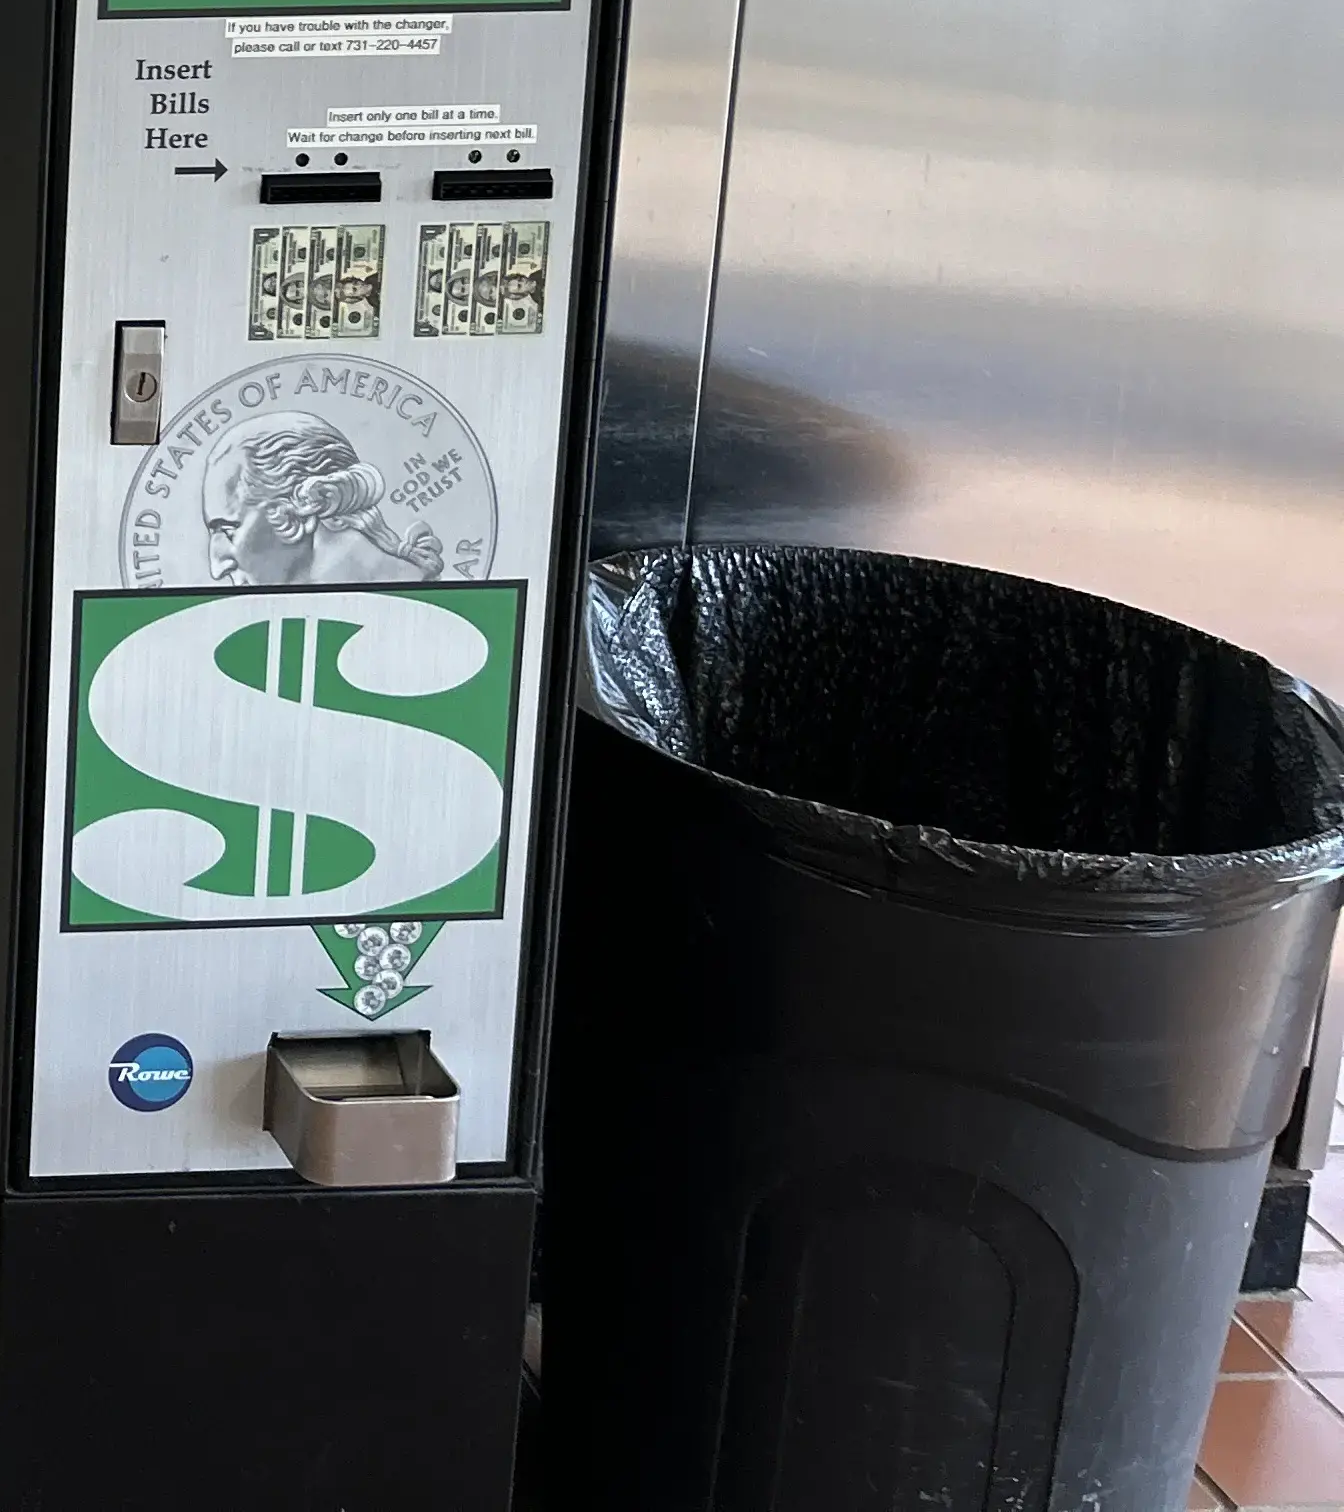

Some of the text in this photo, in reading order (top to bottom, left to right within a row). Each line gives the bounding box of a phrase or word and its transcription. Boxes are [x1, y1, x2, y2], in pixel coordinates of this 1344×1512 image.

[227, 19, 450, 33] If you have trouble with the changer,
[234, 43, 274, 54] please
[279, 42, 300, 52] call
[304, 42, 316, 51] or
[319, 41, 342, 51] text
[135, 59, 213, 80] Insert
[150, 92, 210, 115] Bills
[328, 109, 498, 123] Insert only one bill at a time.
[144, 128, 208, 149] Here
[288, 128, 534, 143] Wait for change before inserting next bill.
[145, 398, 234, 500] STATES
[239, 373, 282, 408] OF
[294, 367, 439, 437] AMERICA
[403, 453, 427, 474] IN
[390, 448, 462, 504] GOD WE
[406, 467, 462, 512] TRUST
[109, 1062, 191, 1082] Rowe
